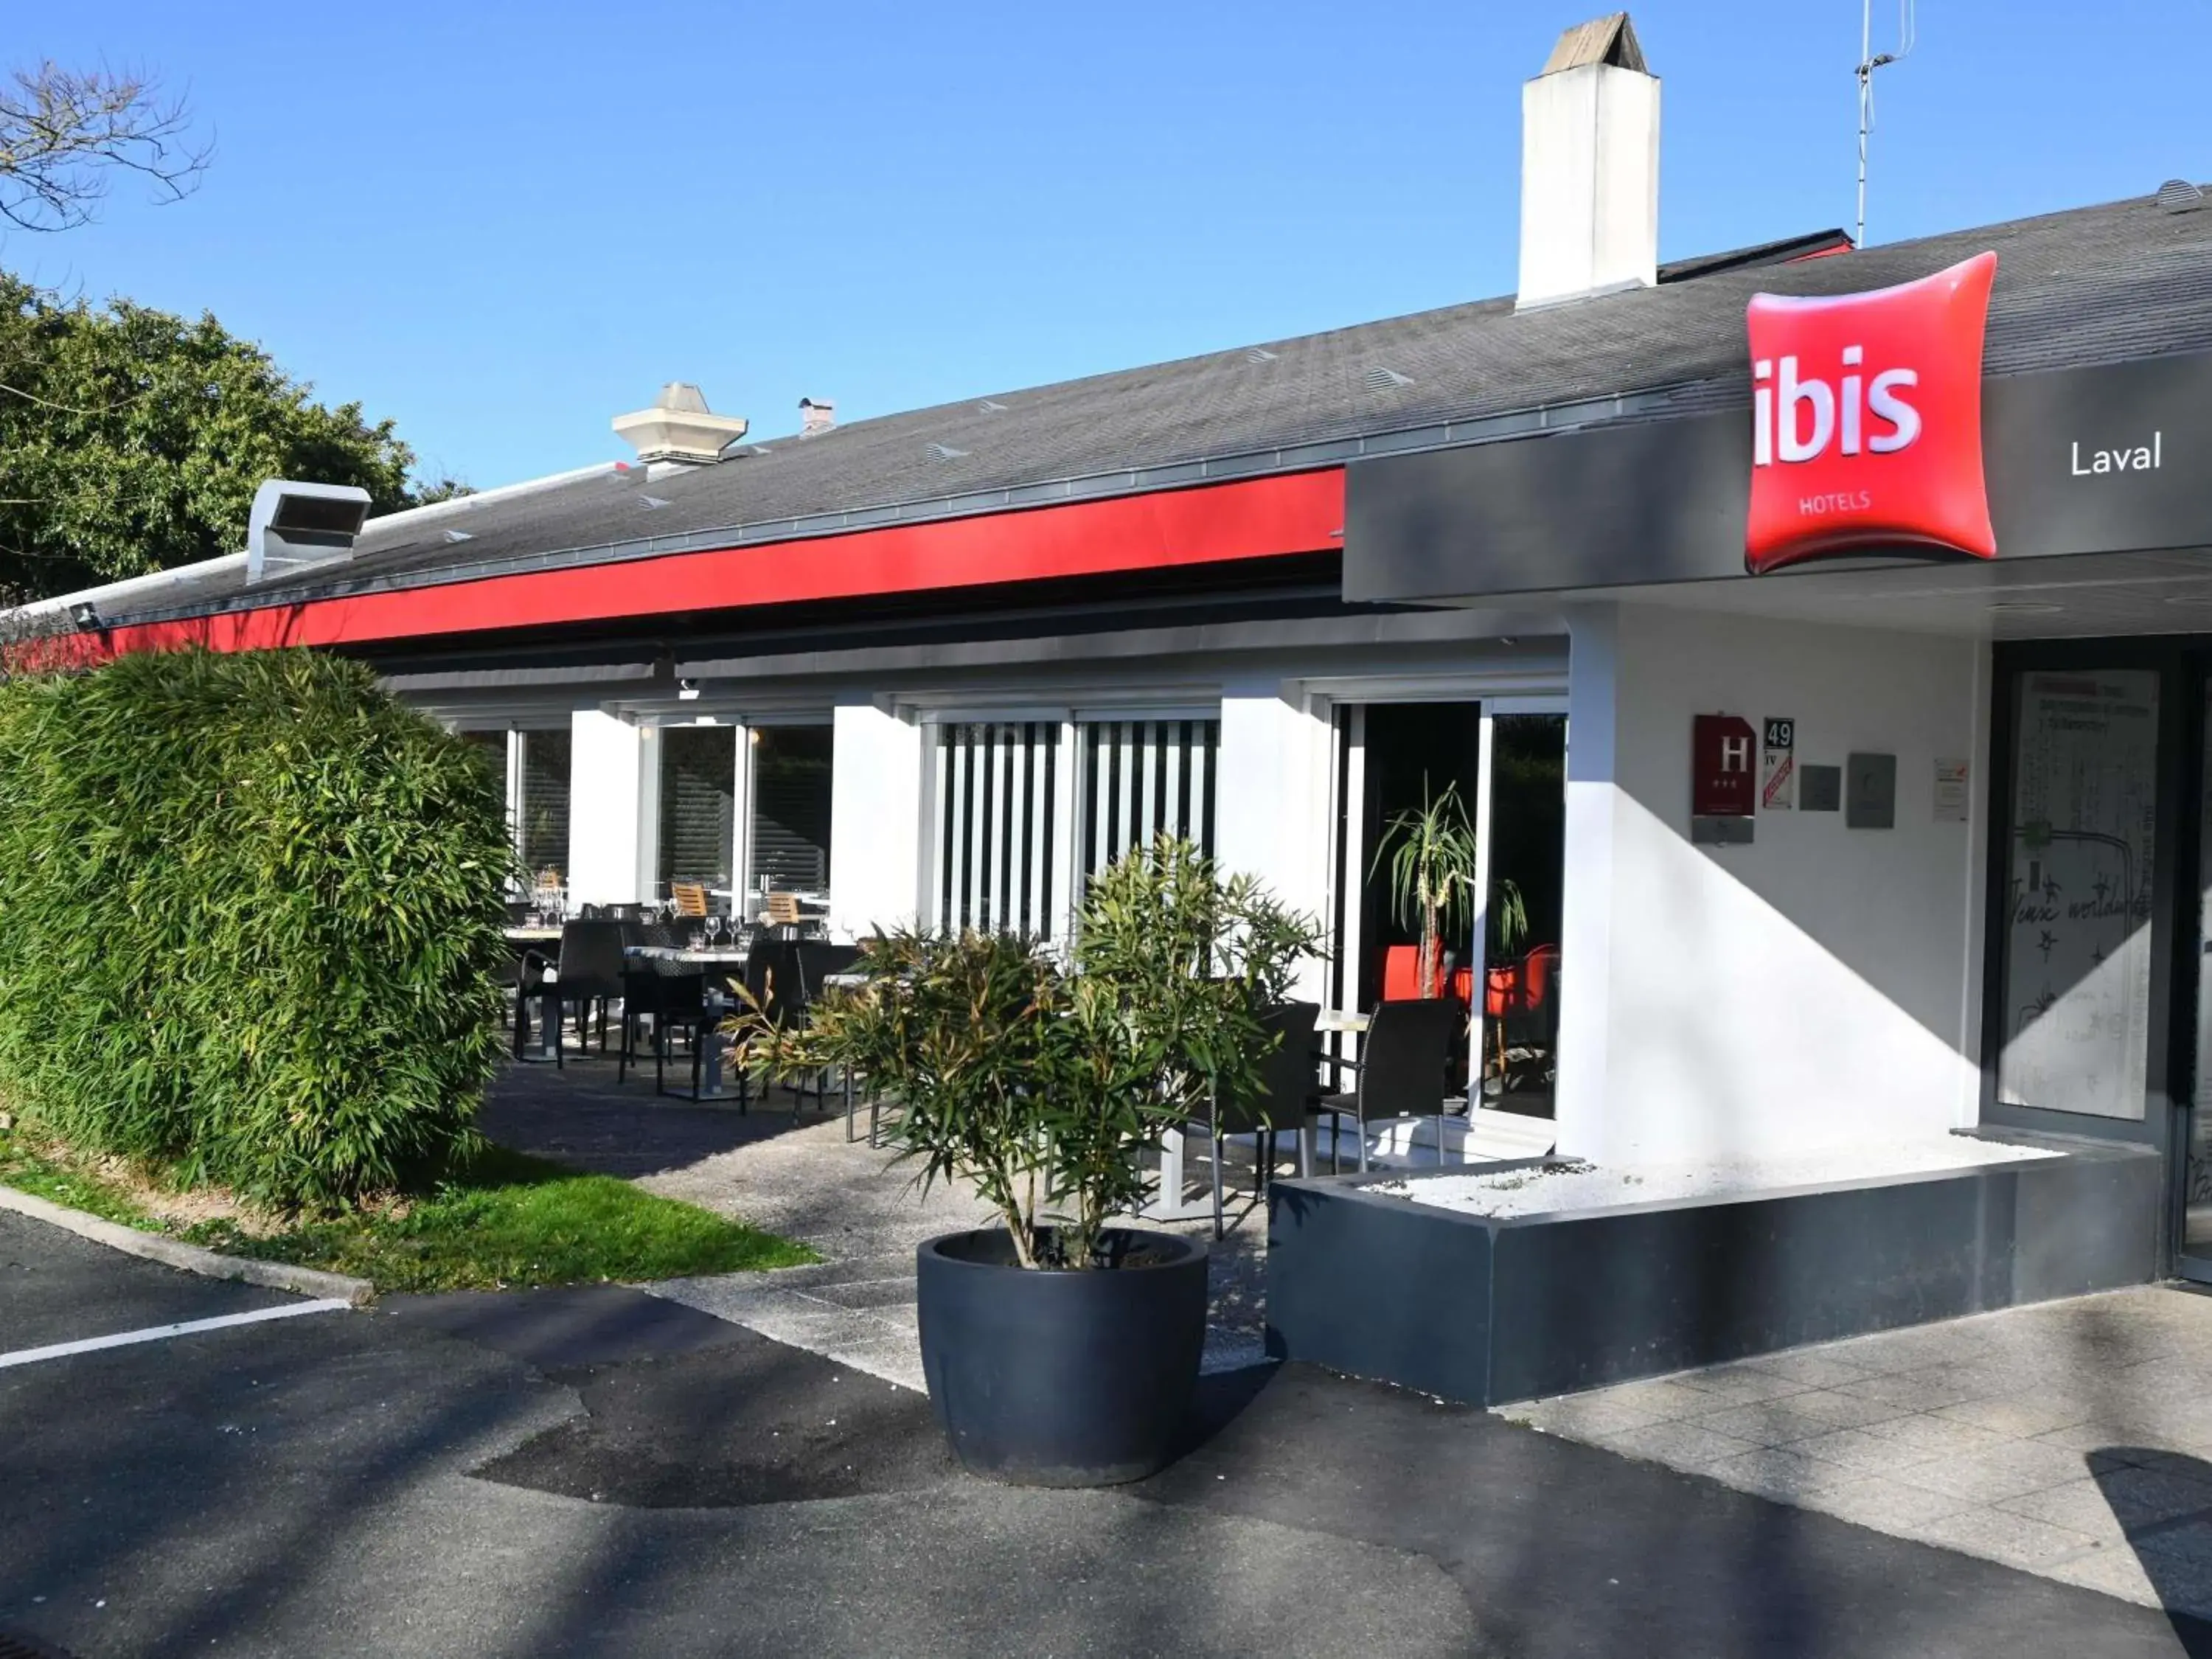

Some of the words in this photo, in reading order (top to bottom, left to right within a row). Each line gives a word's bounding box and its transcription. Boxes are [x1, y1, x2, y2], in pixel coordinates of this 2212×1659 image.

[1754, 345, 1921, 467] ibis
[2072, 431, 2161, 476] Laval
[1800, 490, 1871, 516] HOTELS
[1768, 723, 1791, 745] 49
[1722, 736, 1748, 772] H
